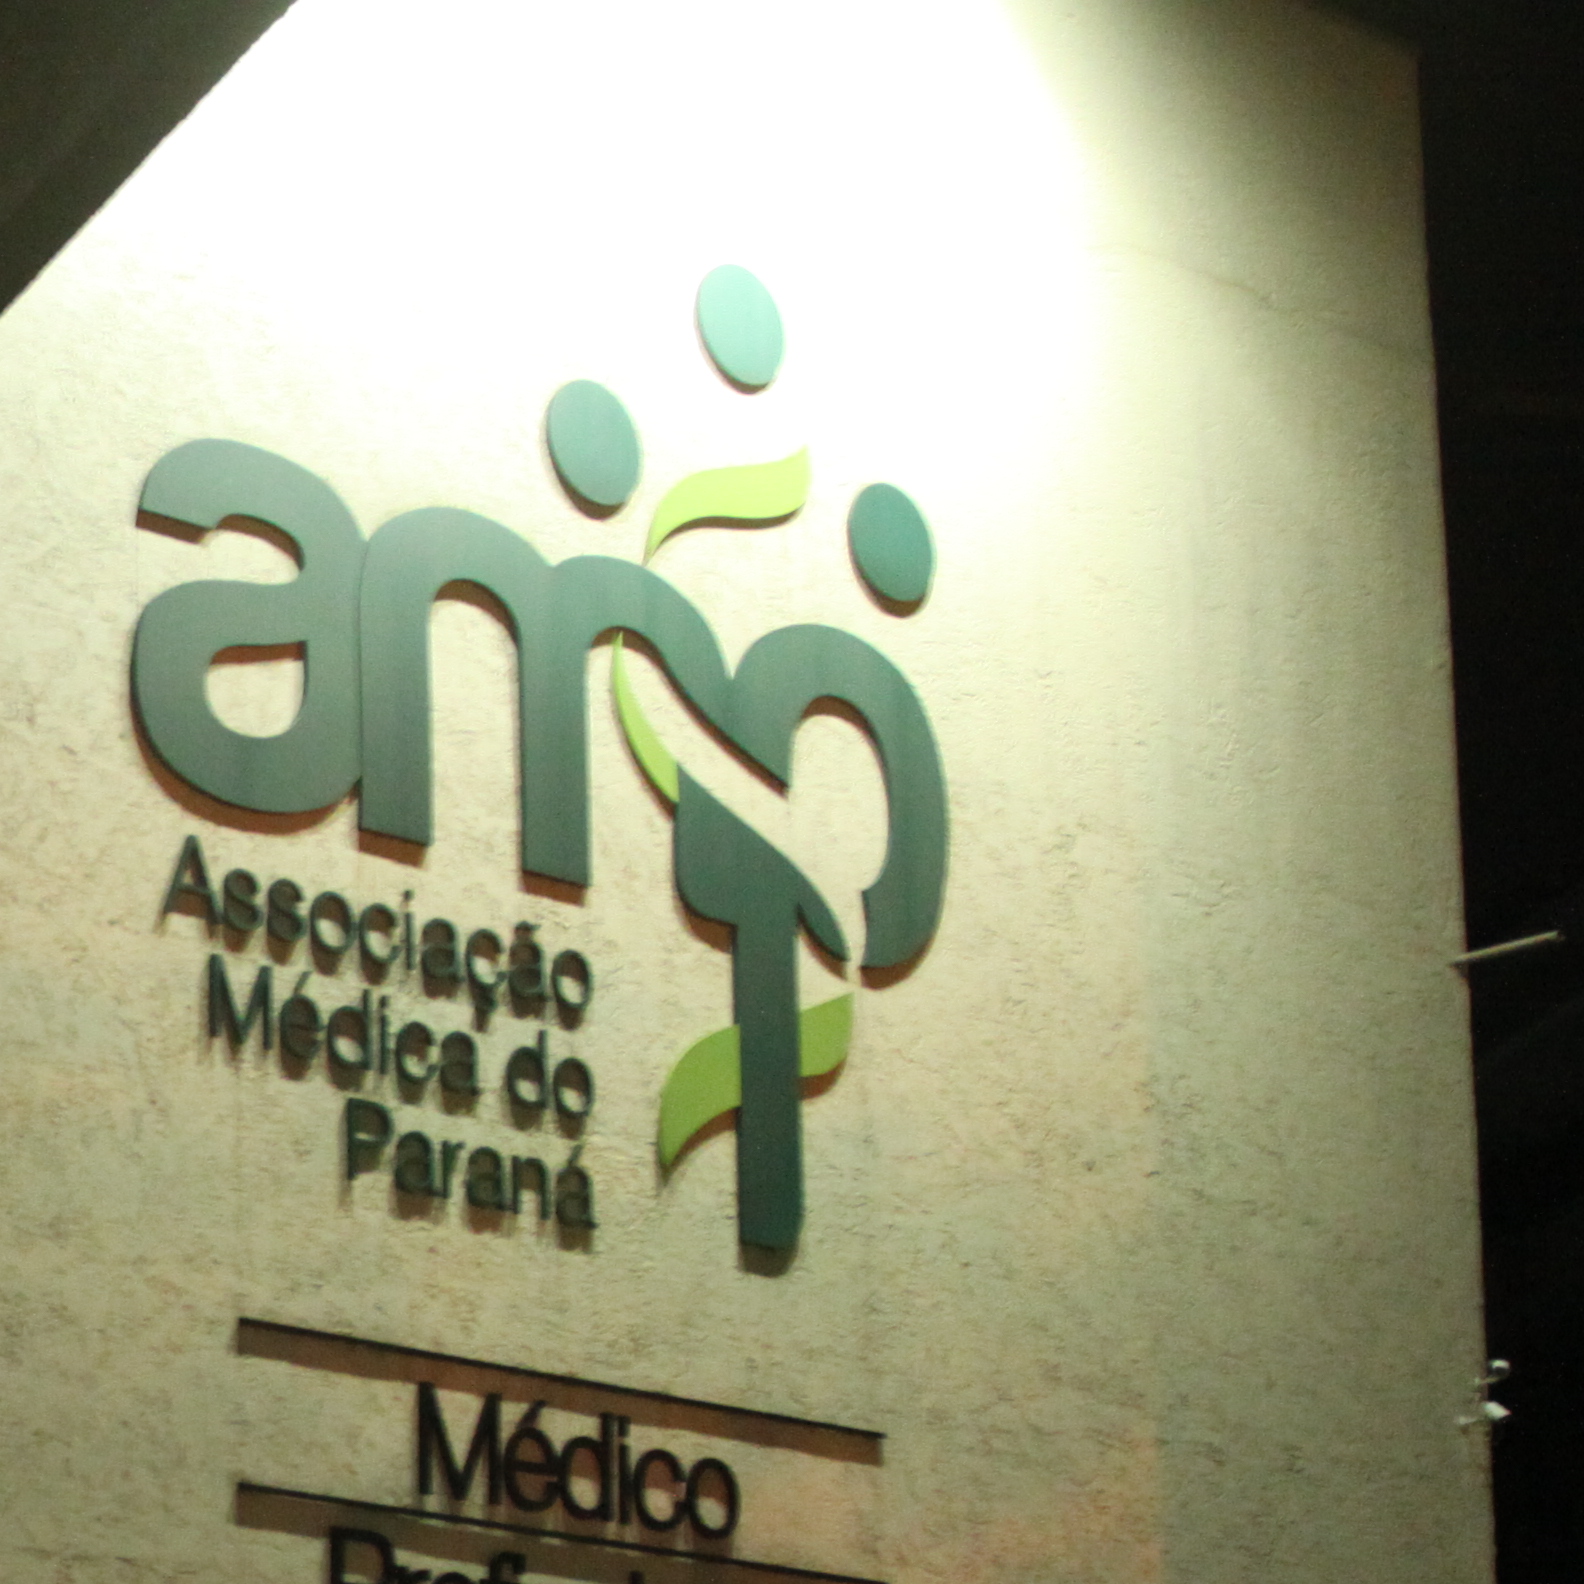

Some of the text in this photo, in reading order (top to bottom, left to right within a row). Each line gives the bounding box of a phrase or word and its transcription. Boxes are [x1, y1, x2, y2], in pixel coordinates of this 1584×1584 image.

[162, 835, 594, 1014] Associação
[207, 953, 595, 1119] Médica do
[344, 1097, 599, 1230] Paraná
[415, 1380, 742, 1541] Médico
